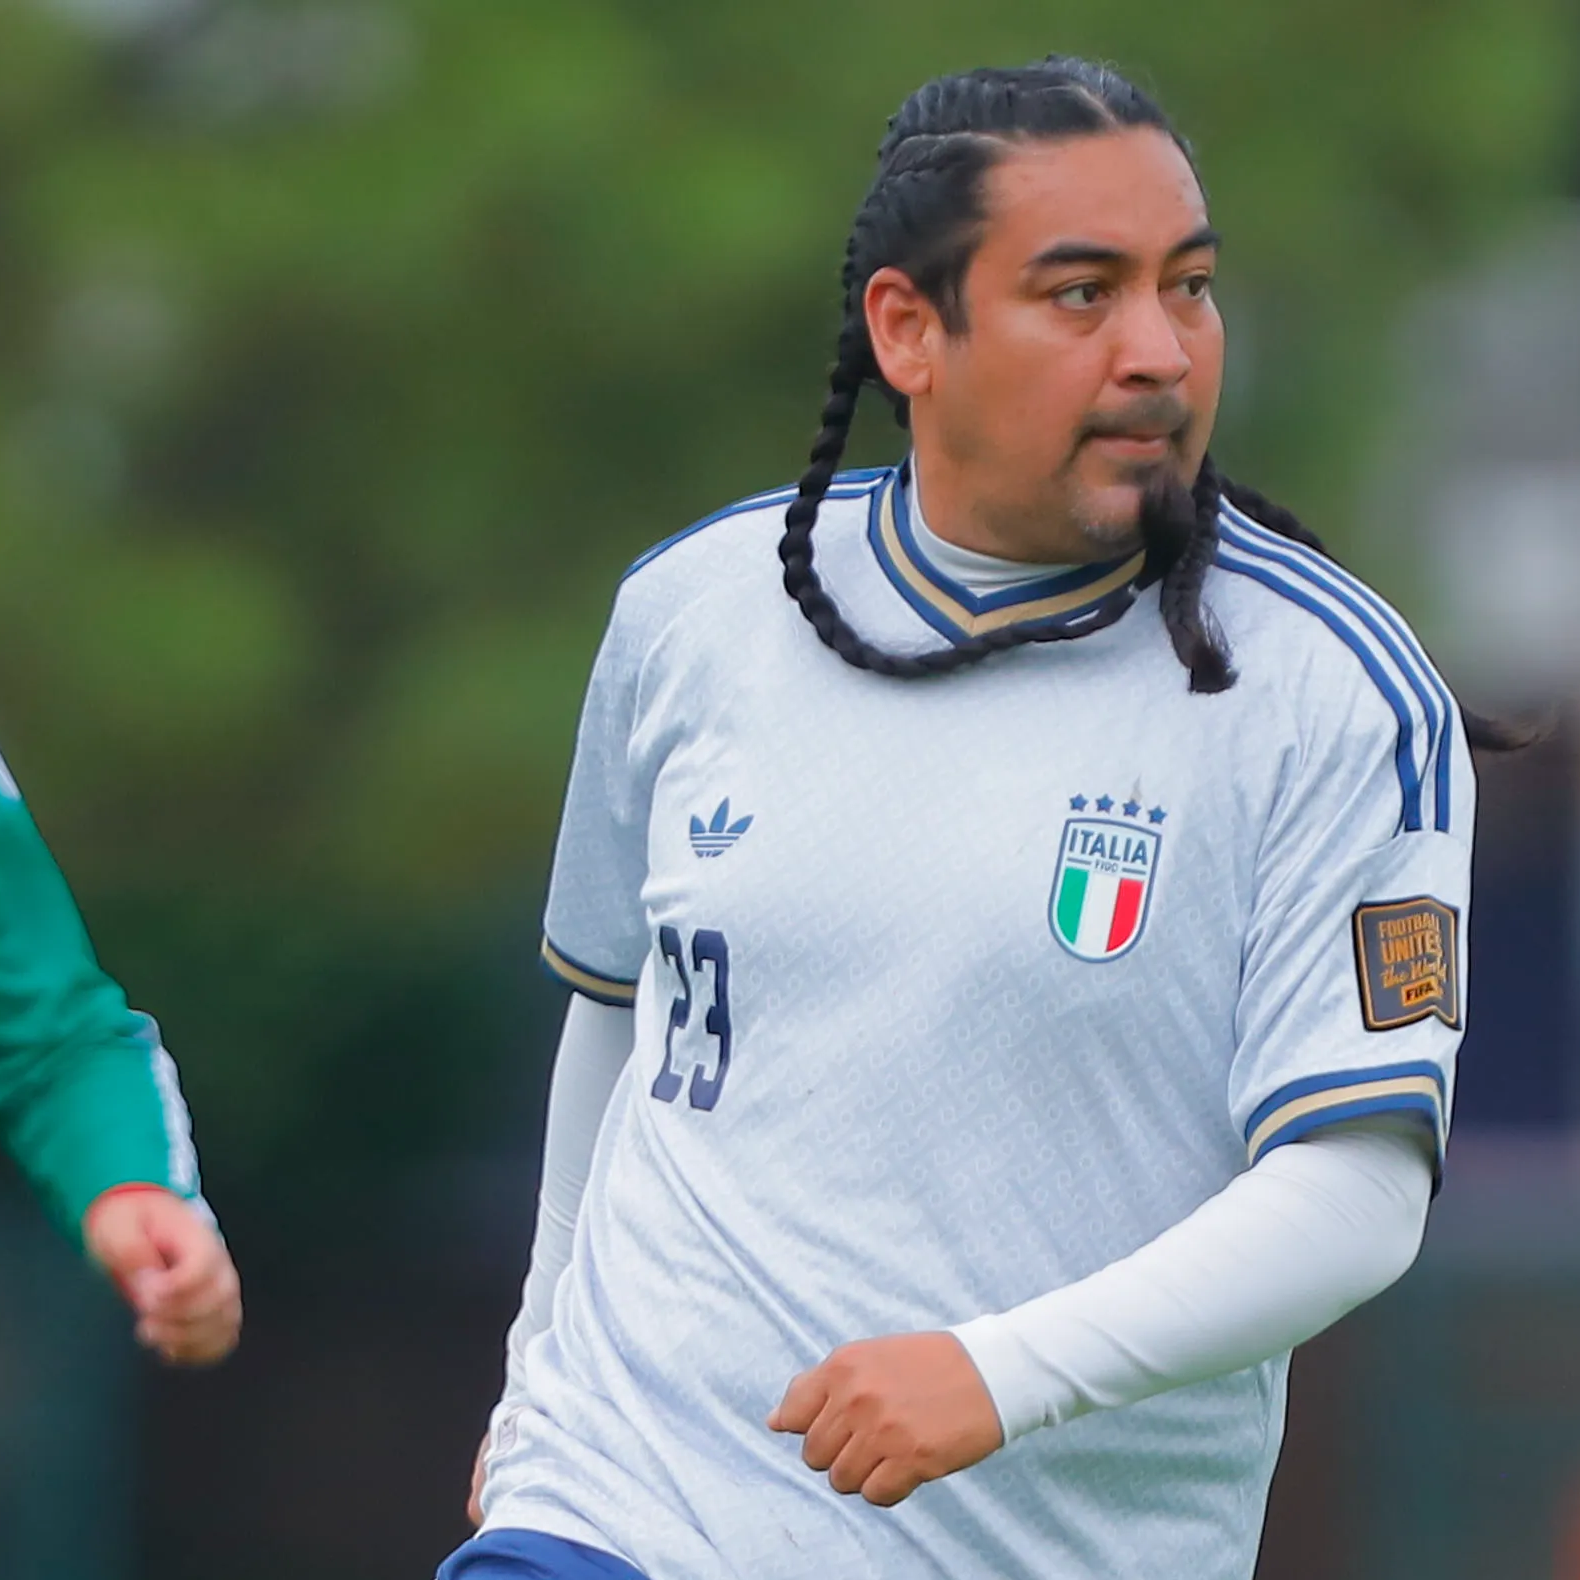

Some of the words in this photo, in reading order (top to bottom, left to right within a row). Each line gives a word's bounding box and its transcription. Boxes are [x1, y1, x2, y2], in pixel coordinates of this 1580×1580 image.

[1069, 828, 1148, 865] ITALIA
[1404, 980, 1435, 1002] FIFA
[651, 925, 732, 1112] 23
